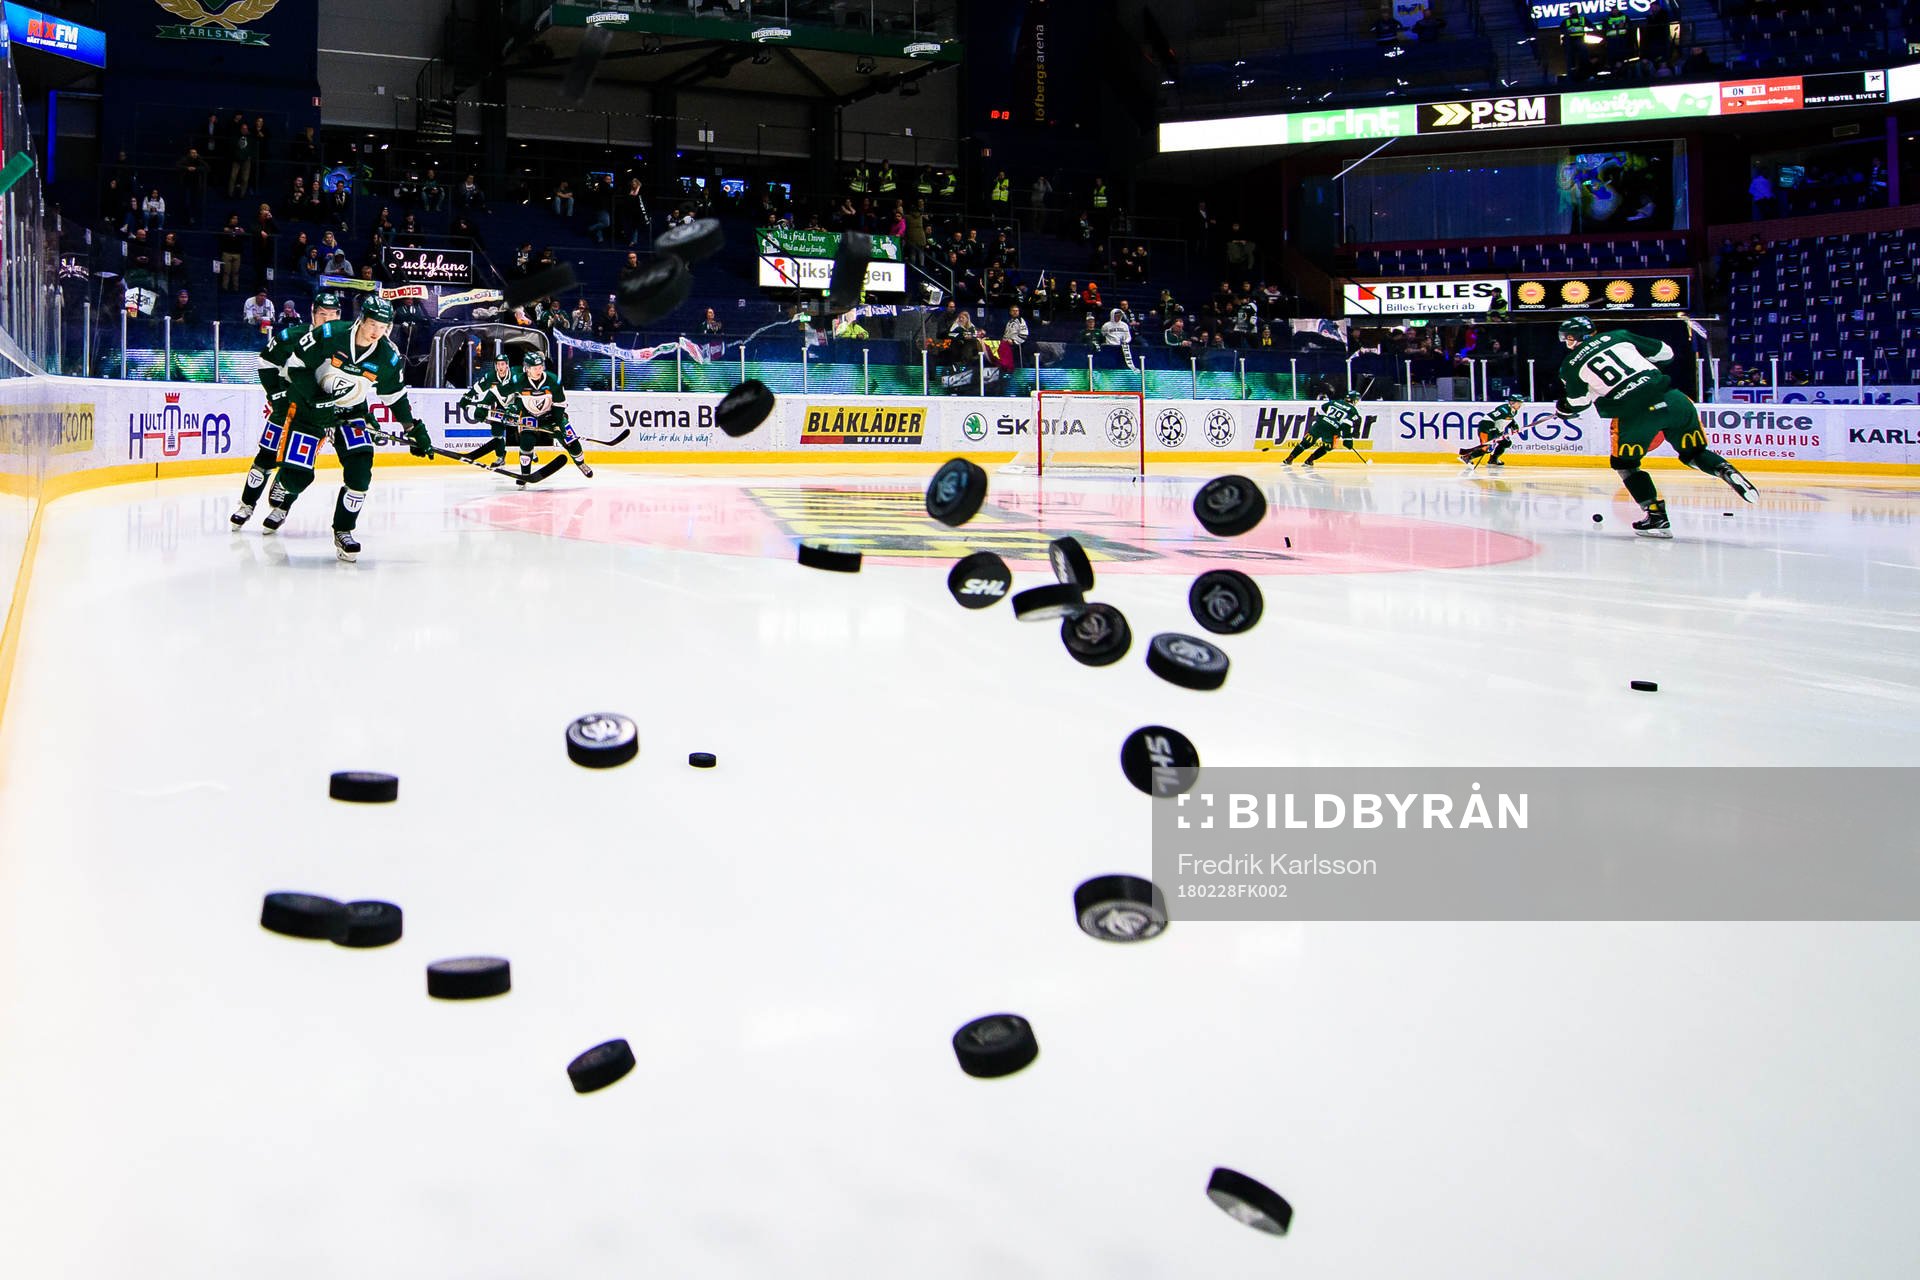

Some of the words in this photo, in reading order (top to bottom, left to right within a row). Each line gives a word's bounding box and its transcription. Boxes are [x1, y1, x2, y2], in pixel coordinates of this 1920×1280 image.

[179, 27, 248, 40] KARLSTAD
[1805, 96, 1826, 104] FIRST
[1470, 97, 1546, 124] PSM
[1386, 283, 1493, 299] BILLES
[1386, 303, 1416, 312] Billes
[1418, 302, 1459, 312] Tryckeri
[1586, 349, 1637, 386] 61
[609, 404, 690, 428] Svema
[807, 408, 922, 433] BLÅKLÄDER
[201, 413, 231, 455] AB
[639, 432, 658, 442] Vart
[669, 432, 681, 442] du
[1525, 442, 1584, 453] arbetsglädje
[960, 578, 1005, 596] SHL
[1144, 734, 1180, 794] SHL
